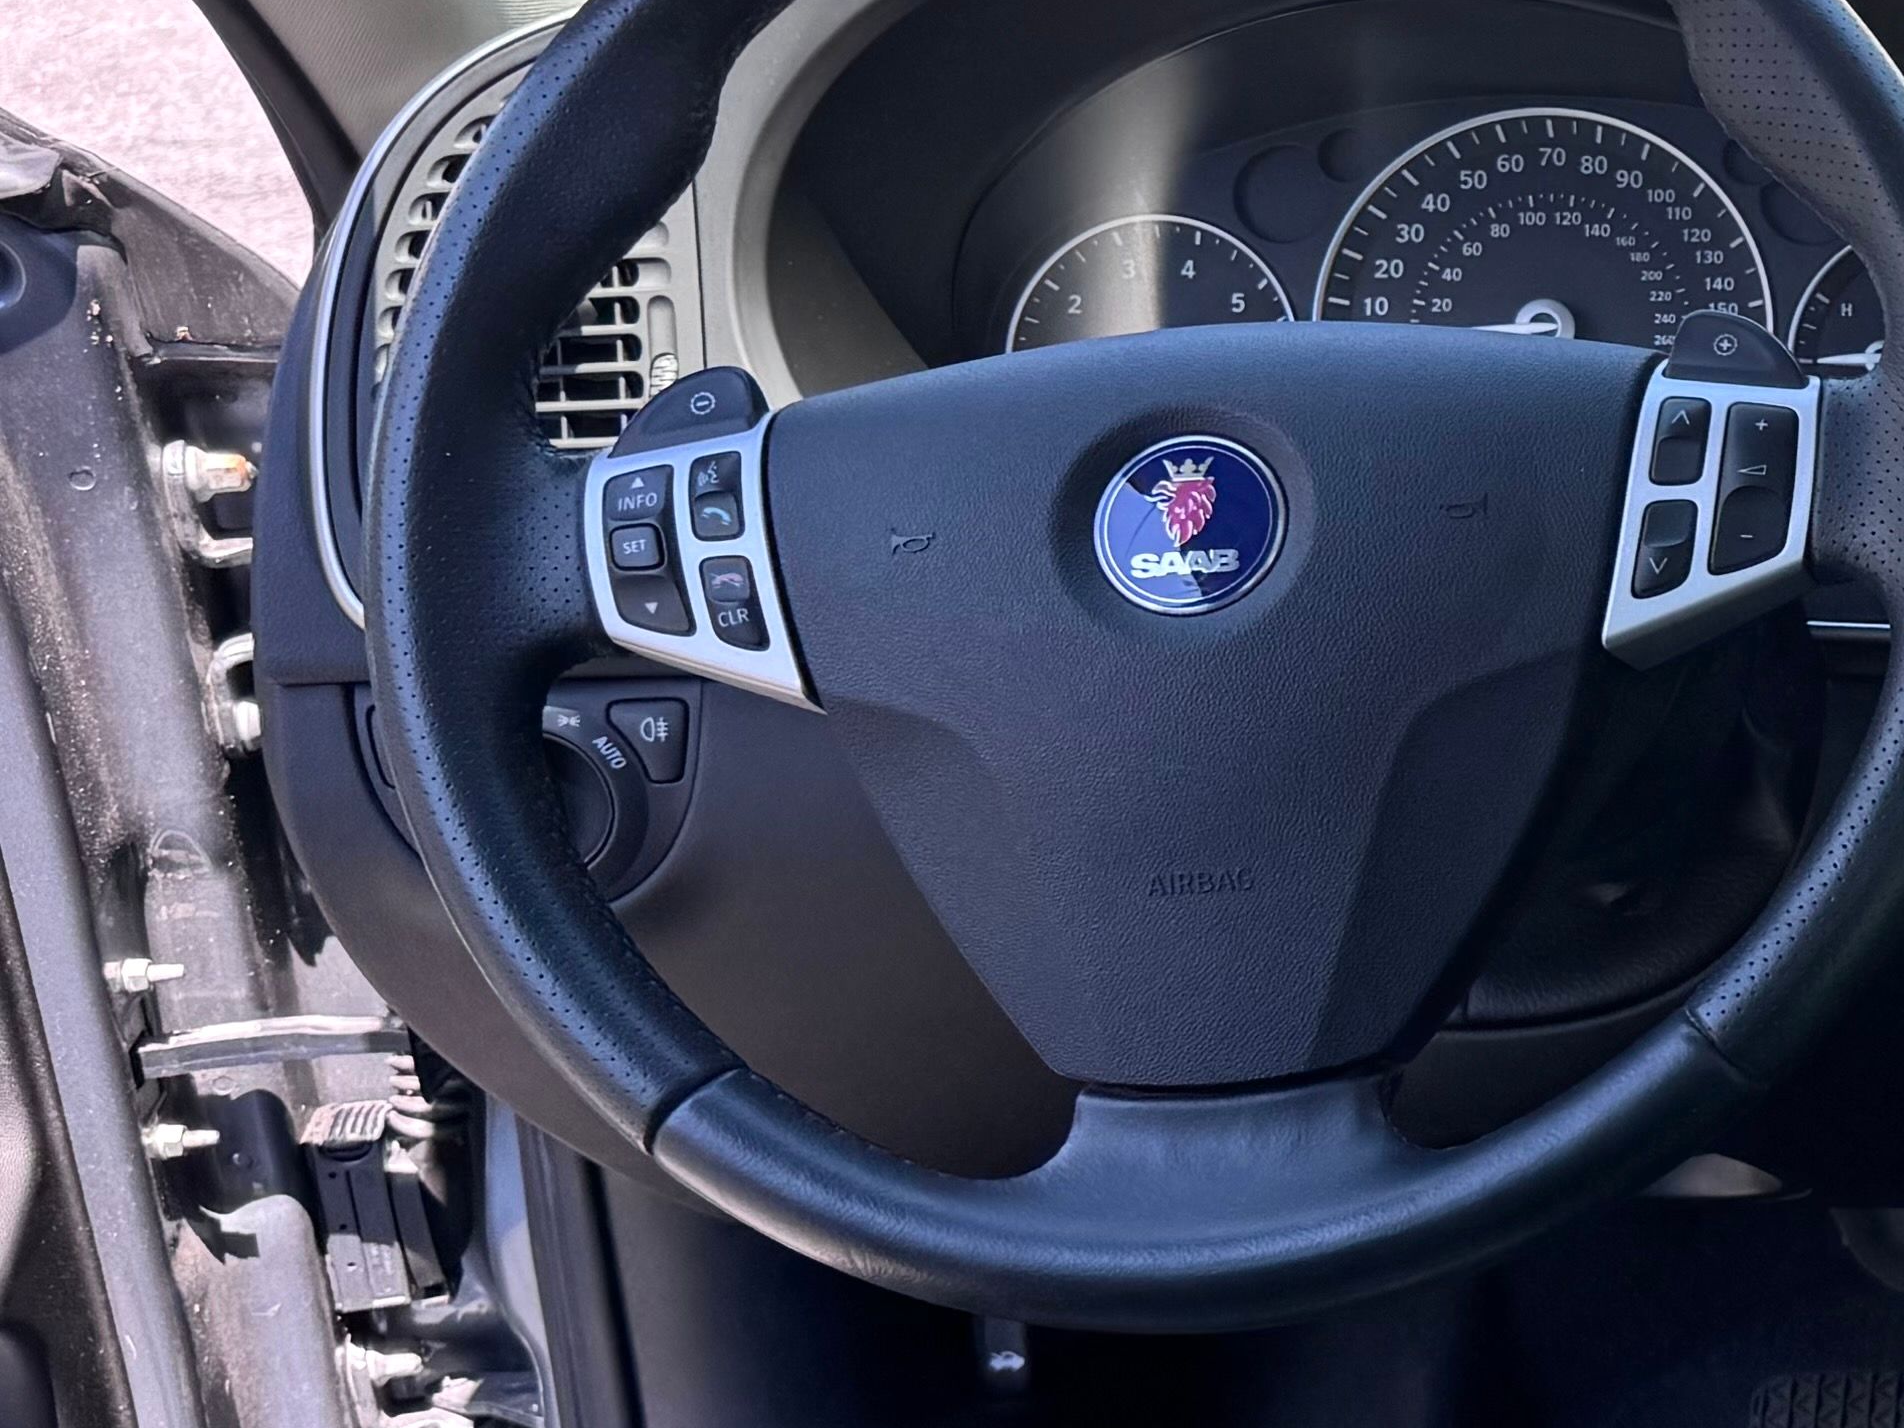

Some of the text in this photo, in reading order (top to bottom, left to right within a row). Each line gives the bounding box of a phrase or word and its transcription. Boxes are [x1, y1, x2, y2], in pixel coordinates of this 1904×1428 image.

[1496, 154, 1524, 173] 60
[1538, 147, 1566, 167] 70
[1580, 155, 1608, 175] 80
[1460, 170, 1488, 190] 50
[1615, 170, 1643, 189] 90
[1420, 193, 1450, 213] 40
[1647, 189, 1675, 203] 100
[1518, 211, 1546, 226] 100
[1555, 211, 1582, 226] 120
[1666, 206, 1692, 221] 110
[1395, 223, 1425, 243] 30
[1490, 224, 1510, 238] 80
[1584, 224, 1611, 238] 140
[1683, 228, 1711, 243] 120
[1462, 242, 1482, 256] 60
[1616, 235, 1636, 247] 160
[1695, 250, 1724, 265] 130
[1122, 259, 1137, 280] 3
[1180, 259, 1196, 280] 4
[1374, 259, 1404, 279] 20
[1441, 268, 1462, 282] 40
[1641, 270, 1663, 282] 200
[1704, 276, 1735, 292] 140
[1068, 294, 1083, 315] 2
[1231, 292, 1246, 314] 5
[1649, 290, 1672, 302] 220
[1364, 296, 1389, 316] 10
[1431, 298, 1453, 313] 20
[1841, 302, 1853, 317] H
[1654, 313, 1676, 324] 240
[617, 491, 659, 513] INFO
[622, 539, 647, 556] SET
[1130, 548, 1241, 579] SAAB
[718, 607, 751, 629] CLR
[592, 735, 628, 771] AUTO
[1148, 866, 1255, 897] AIRBAG
